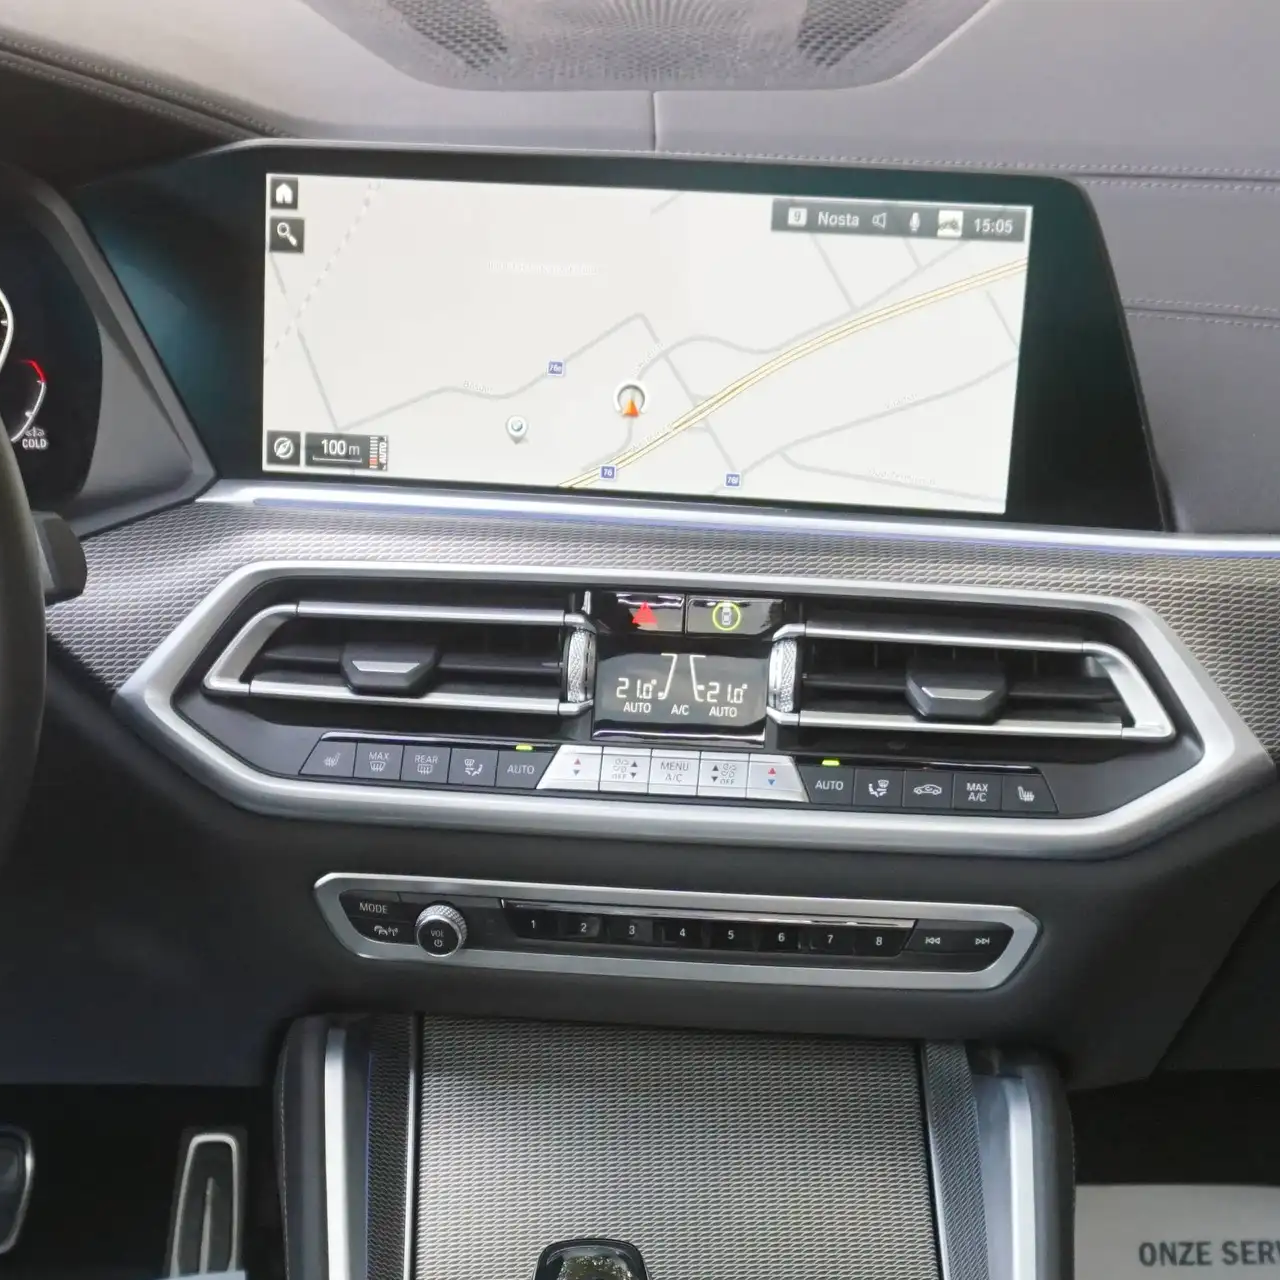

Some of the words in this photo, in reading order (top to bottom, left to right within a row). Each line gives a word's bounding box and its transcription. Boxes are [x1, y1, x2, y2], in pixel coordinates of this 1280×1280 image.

[818, 210, 860, 228] Nosta
[974, 217, 1014, 235] 15:05
[22, 438, 47, 449] COLD
[321, 439, 346, 455] 100
[348, 445, 360, 455] m
[623, 702, 652, 714] AUTO
[671, 704, 690, 716] A/C
[709, 706, 738, 718] AUTO
[368, 752, 390, 761] MAX
[414, 754, 438, 765] REAR
[506, 764, 535, 775] AUTO
[660, 761, 689, 772] MENU
[664, 773, 683, 783] A/C
[815, 780, 844, 791] AUTO
[966, 783, 988, 793] MAX
[968, 792, 987, 803] A/C
[359, 902, 388, 915] MODE
[531, 919, 537, 930] 1
[580, 922, 588, 934] 2
[628, 924, 636, 936] 3
[430, 929, 444, 938] VOL
[679, 927, 687, 938] 4
[727, 928, 735, 941] 5
[777, 932, 786, 943] 6
[827, 934, 834, 945] 7
[875, 936, 883, 948] 8
[1138, 1241, 1212, 1267] ONZE
